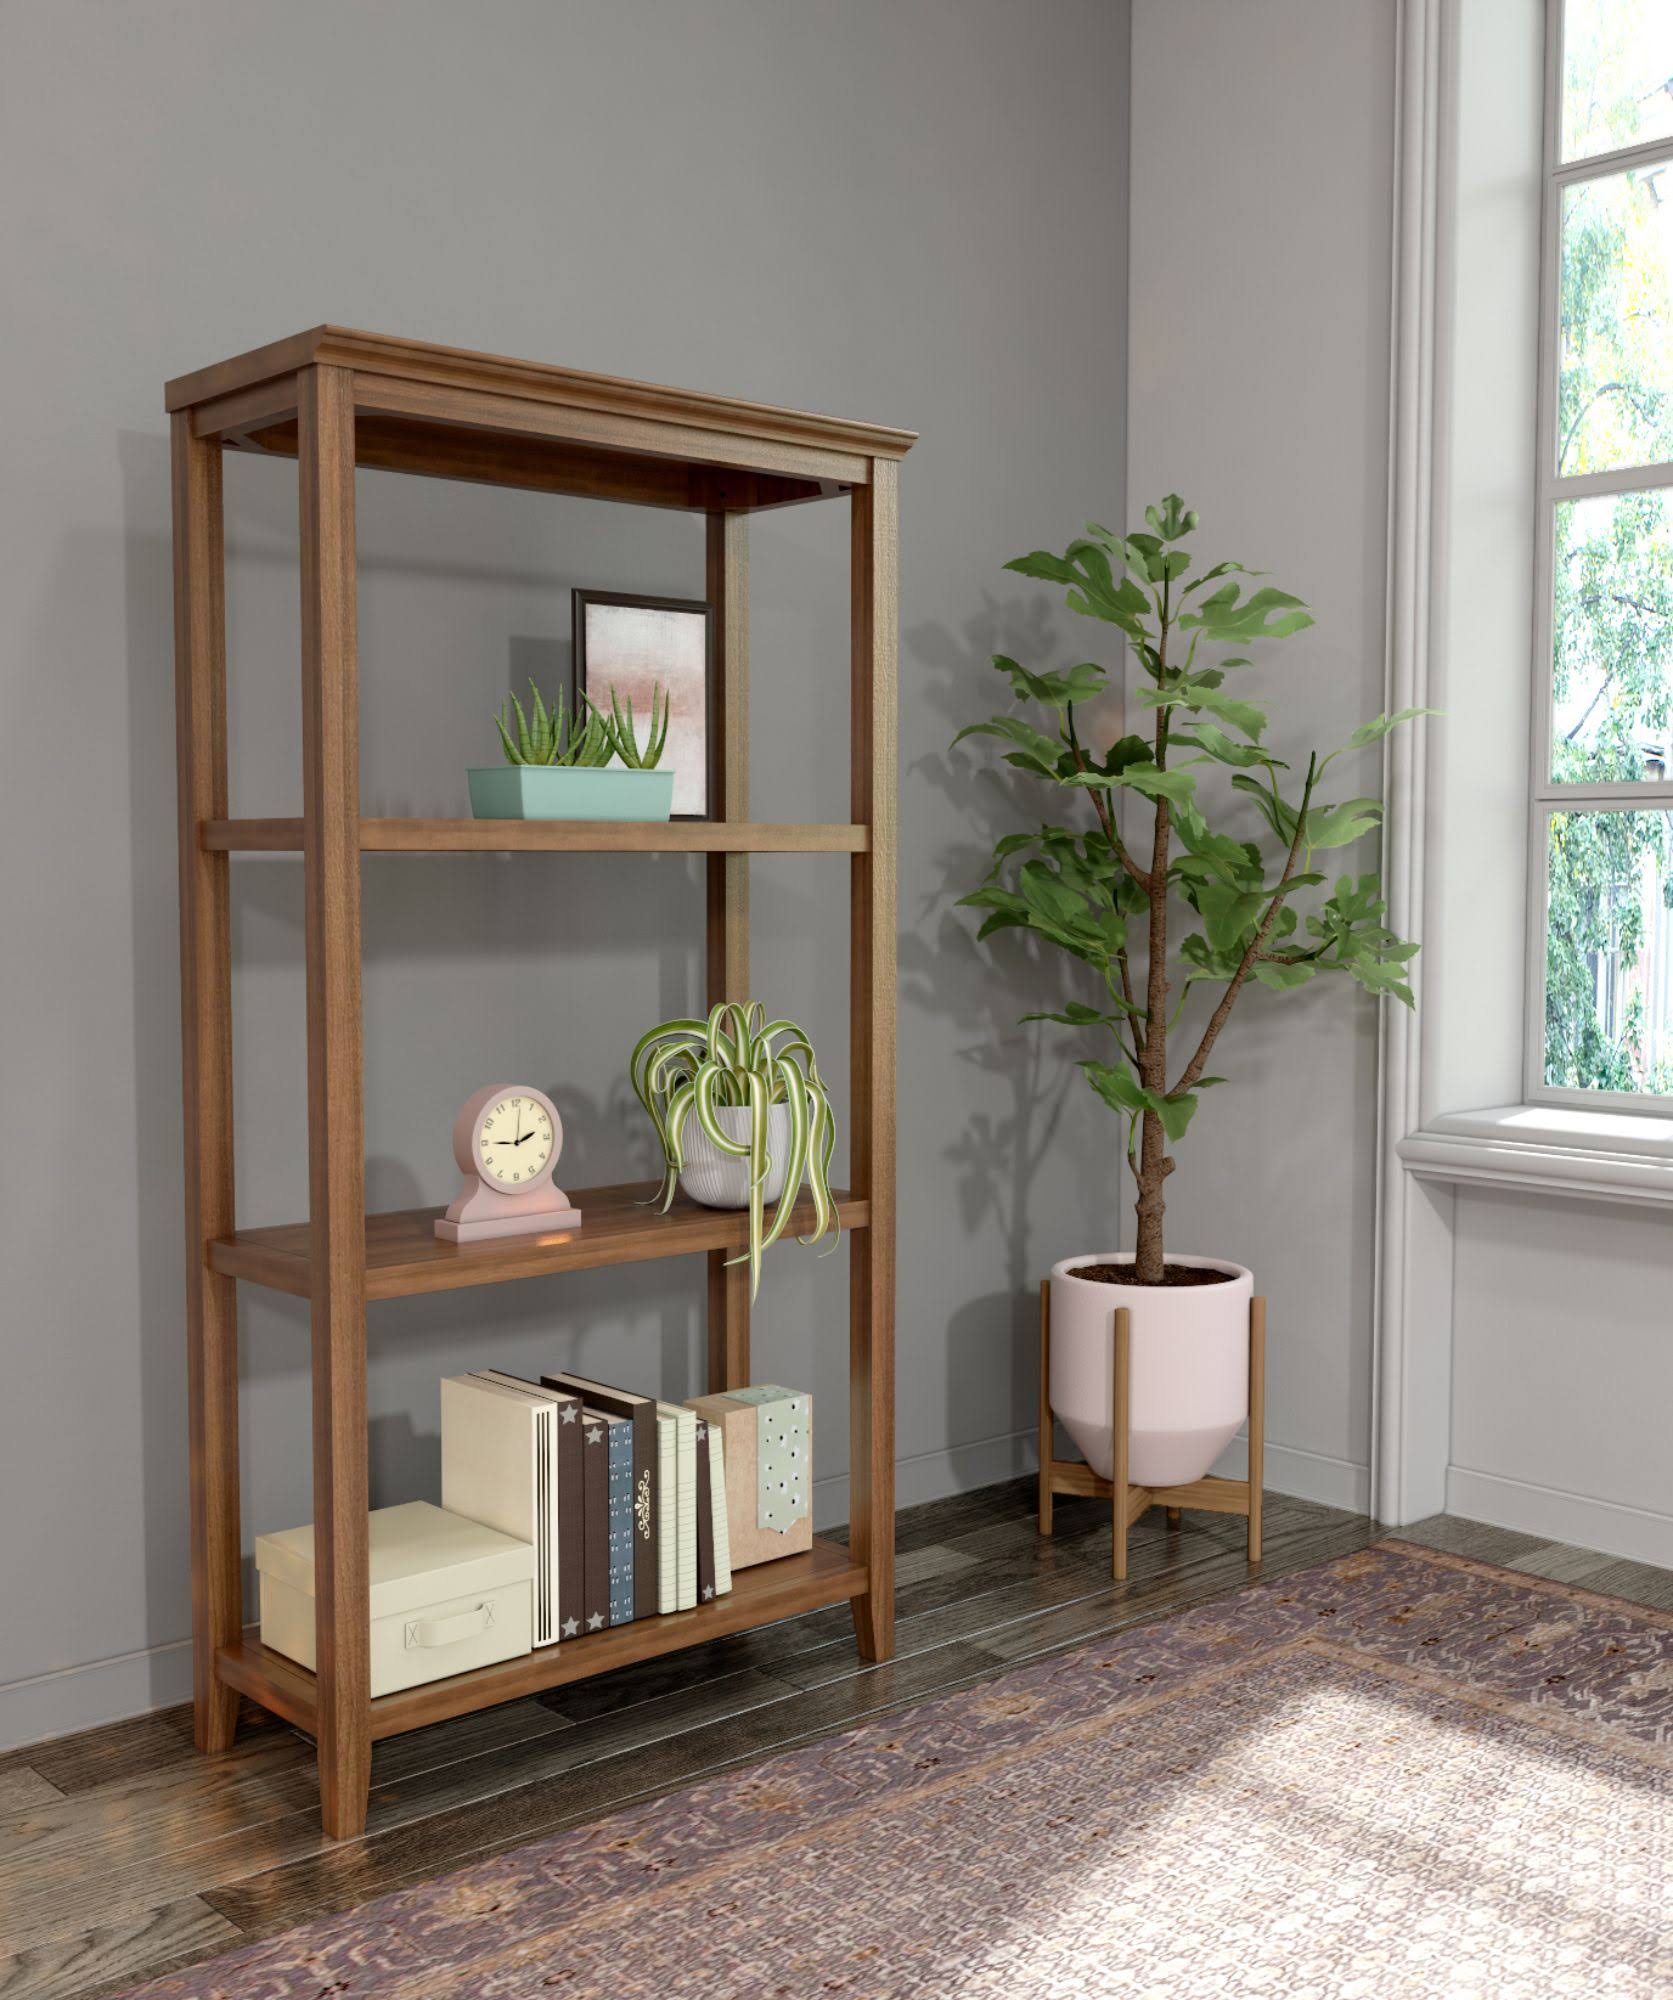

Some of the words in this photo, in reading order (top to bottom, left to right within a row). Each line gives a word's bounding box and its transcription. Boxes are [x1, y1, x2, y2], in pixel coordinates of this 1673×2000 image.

[511, 1099, 521, 1107] 12
[529, 1103, 534, 1111] 1
[496, 1104, 505, 1114] 11
[538, 1115, 547, 1123] 2
[485, 1118, 494, 1129] 10
[497, 1170, 503, 1178] 7
[528, 1166, 536, 1174] 5
